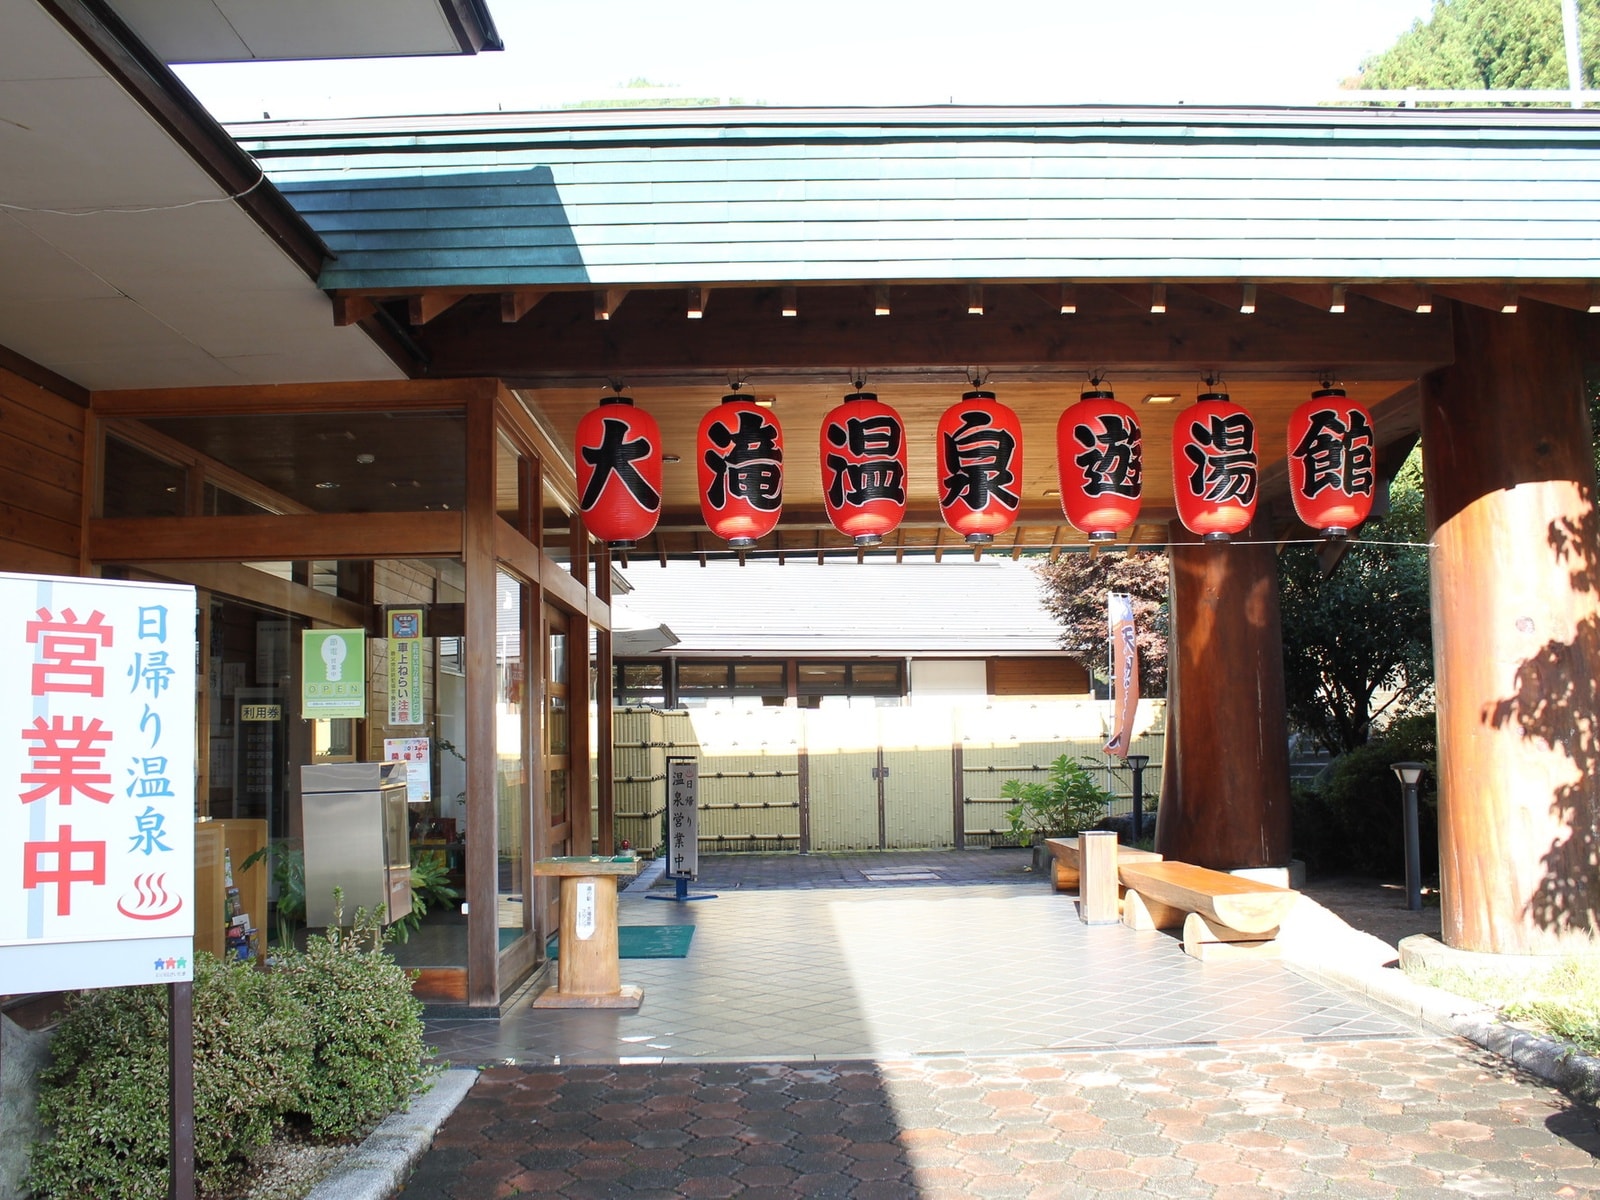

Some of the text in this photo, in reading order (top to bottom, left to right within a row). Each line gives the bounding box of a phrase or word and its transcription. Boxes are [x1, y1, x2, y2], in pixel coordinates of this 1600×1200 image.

[580, 409, 1374, 513] 大 滝 温 泉 遊 湯 館
[18, 606, 115, 917] 営業中
[126, 604, 175, 856] 日帰り温泉
[242, 706, 280, 719] 利用券
[672, 771, 685, 869] 温泉営業中
[685, 780, 694, 828] 日帰り
